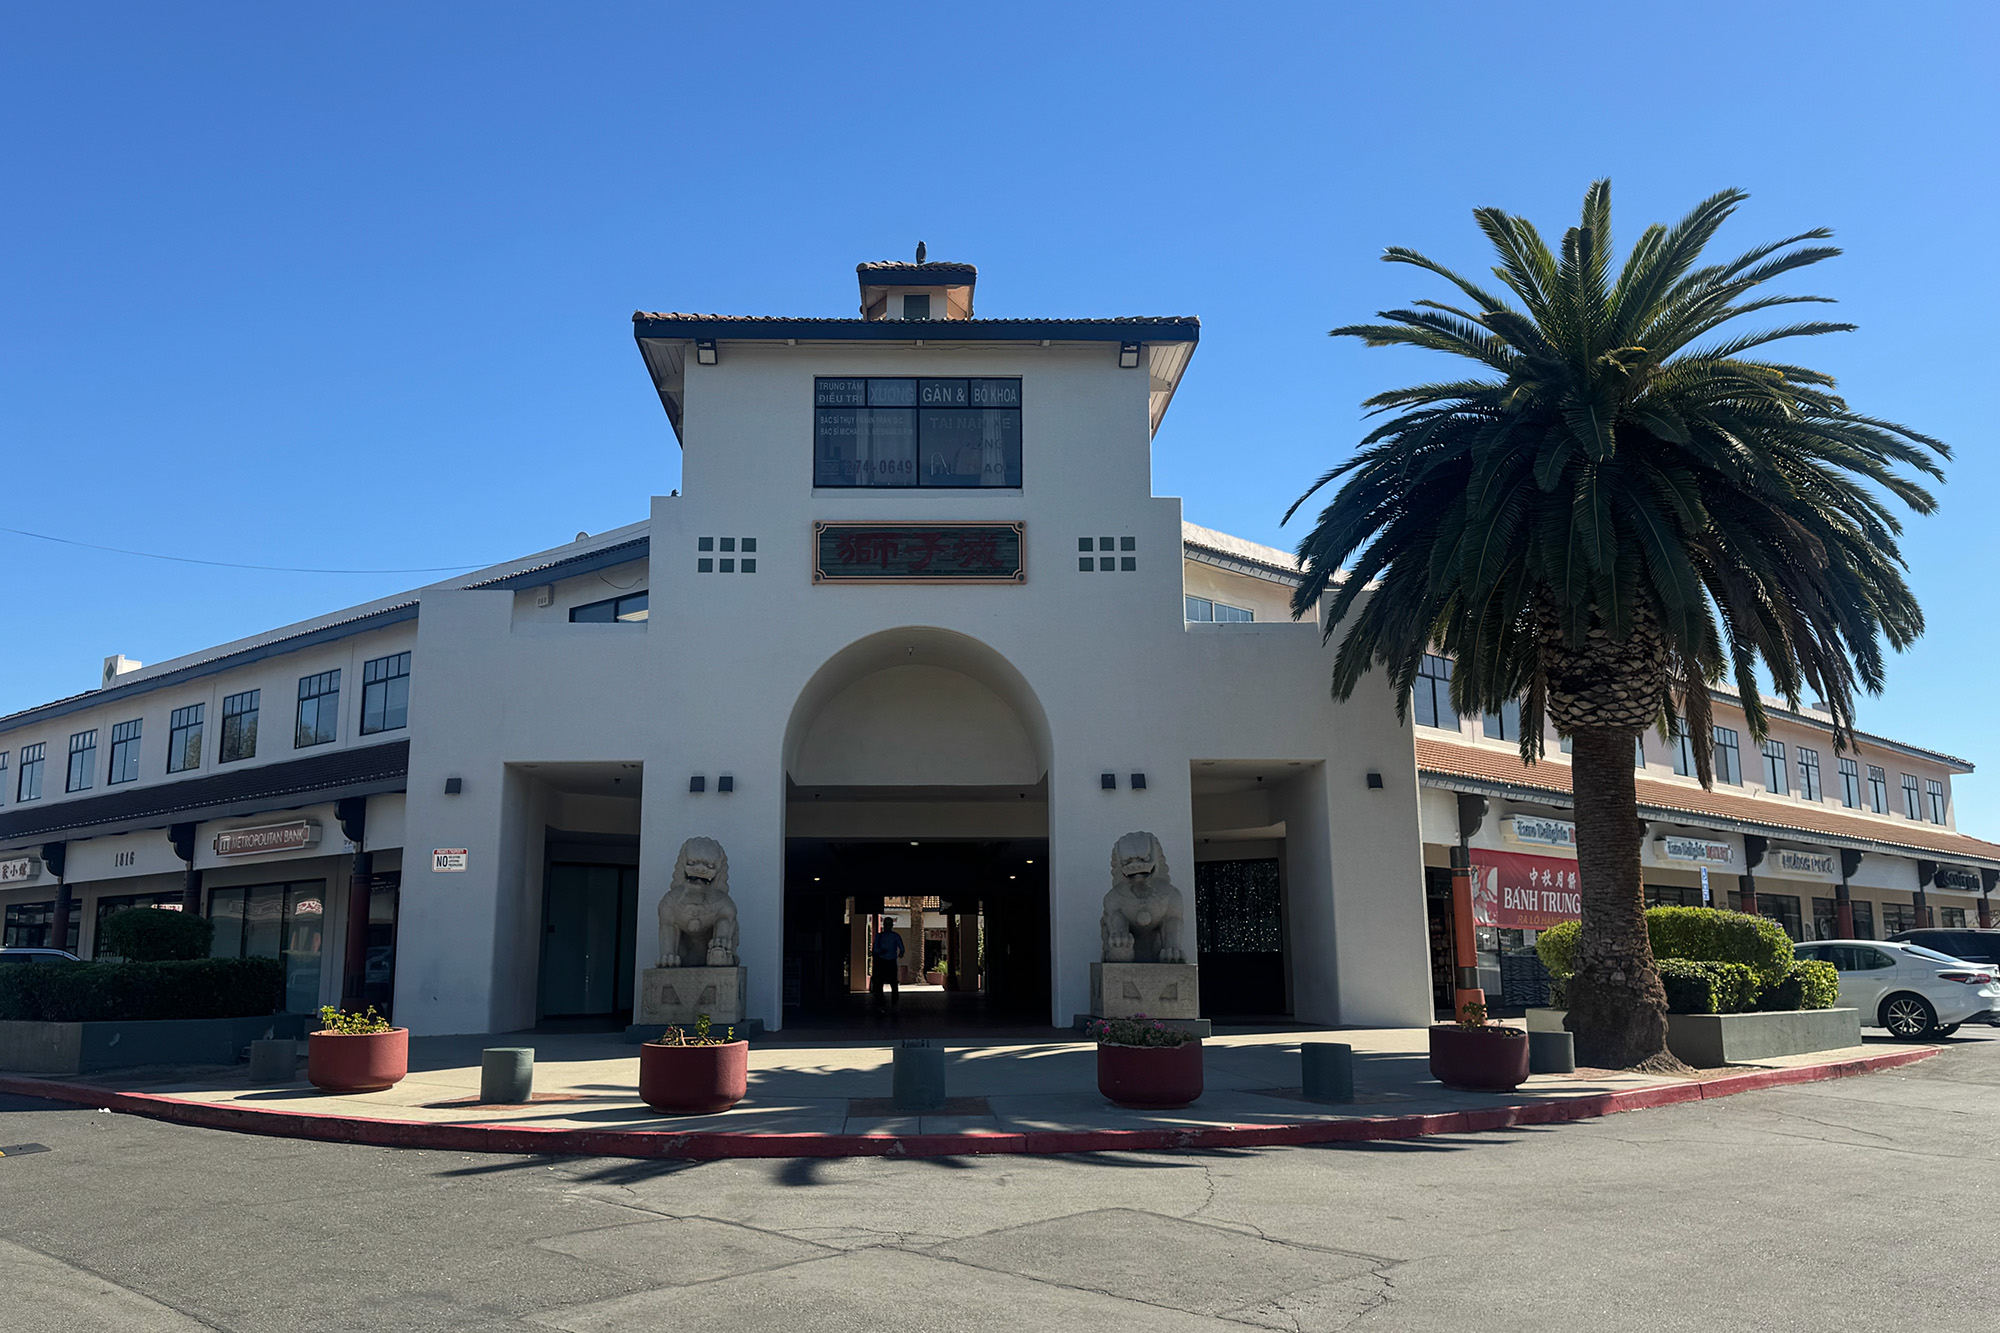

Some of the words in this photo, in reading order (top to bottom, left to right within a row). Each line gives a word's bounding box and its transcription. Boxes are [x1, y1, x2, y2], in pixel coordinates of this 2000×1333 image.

[819, 382, 845, 391] TRUNG
[922, 383, 952, 402] GÂN
[956, 387, 965, 402] &
[990, 387, 1017, 402] KHOA
[846, 459, 913, 474] 274-0649
[231, 832, 282, 849] METROPOLITAN
[284, 828, 305, 842] BANK
[115, 851, 135, 867] 1816
[436, 855, 448, 867] NO
[1504, 886, 1539, 911] BÁNH
[1541, 890, 1581, 914] TRUNG
[1517, 914, 1528, 925] RA
